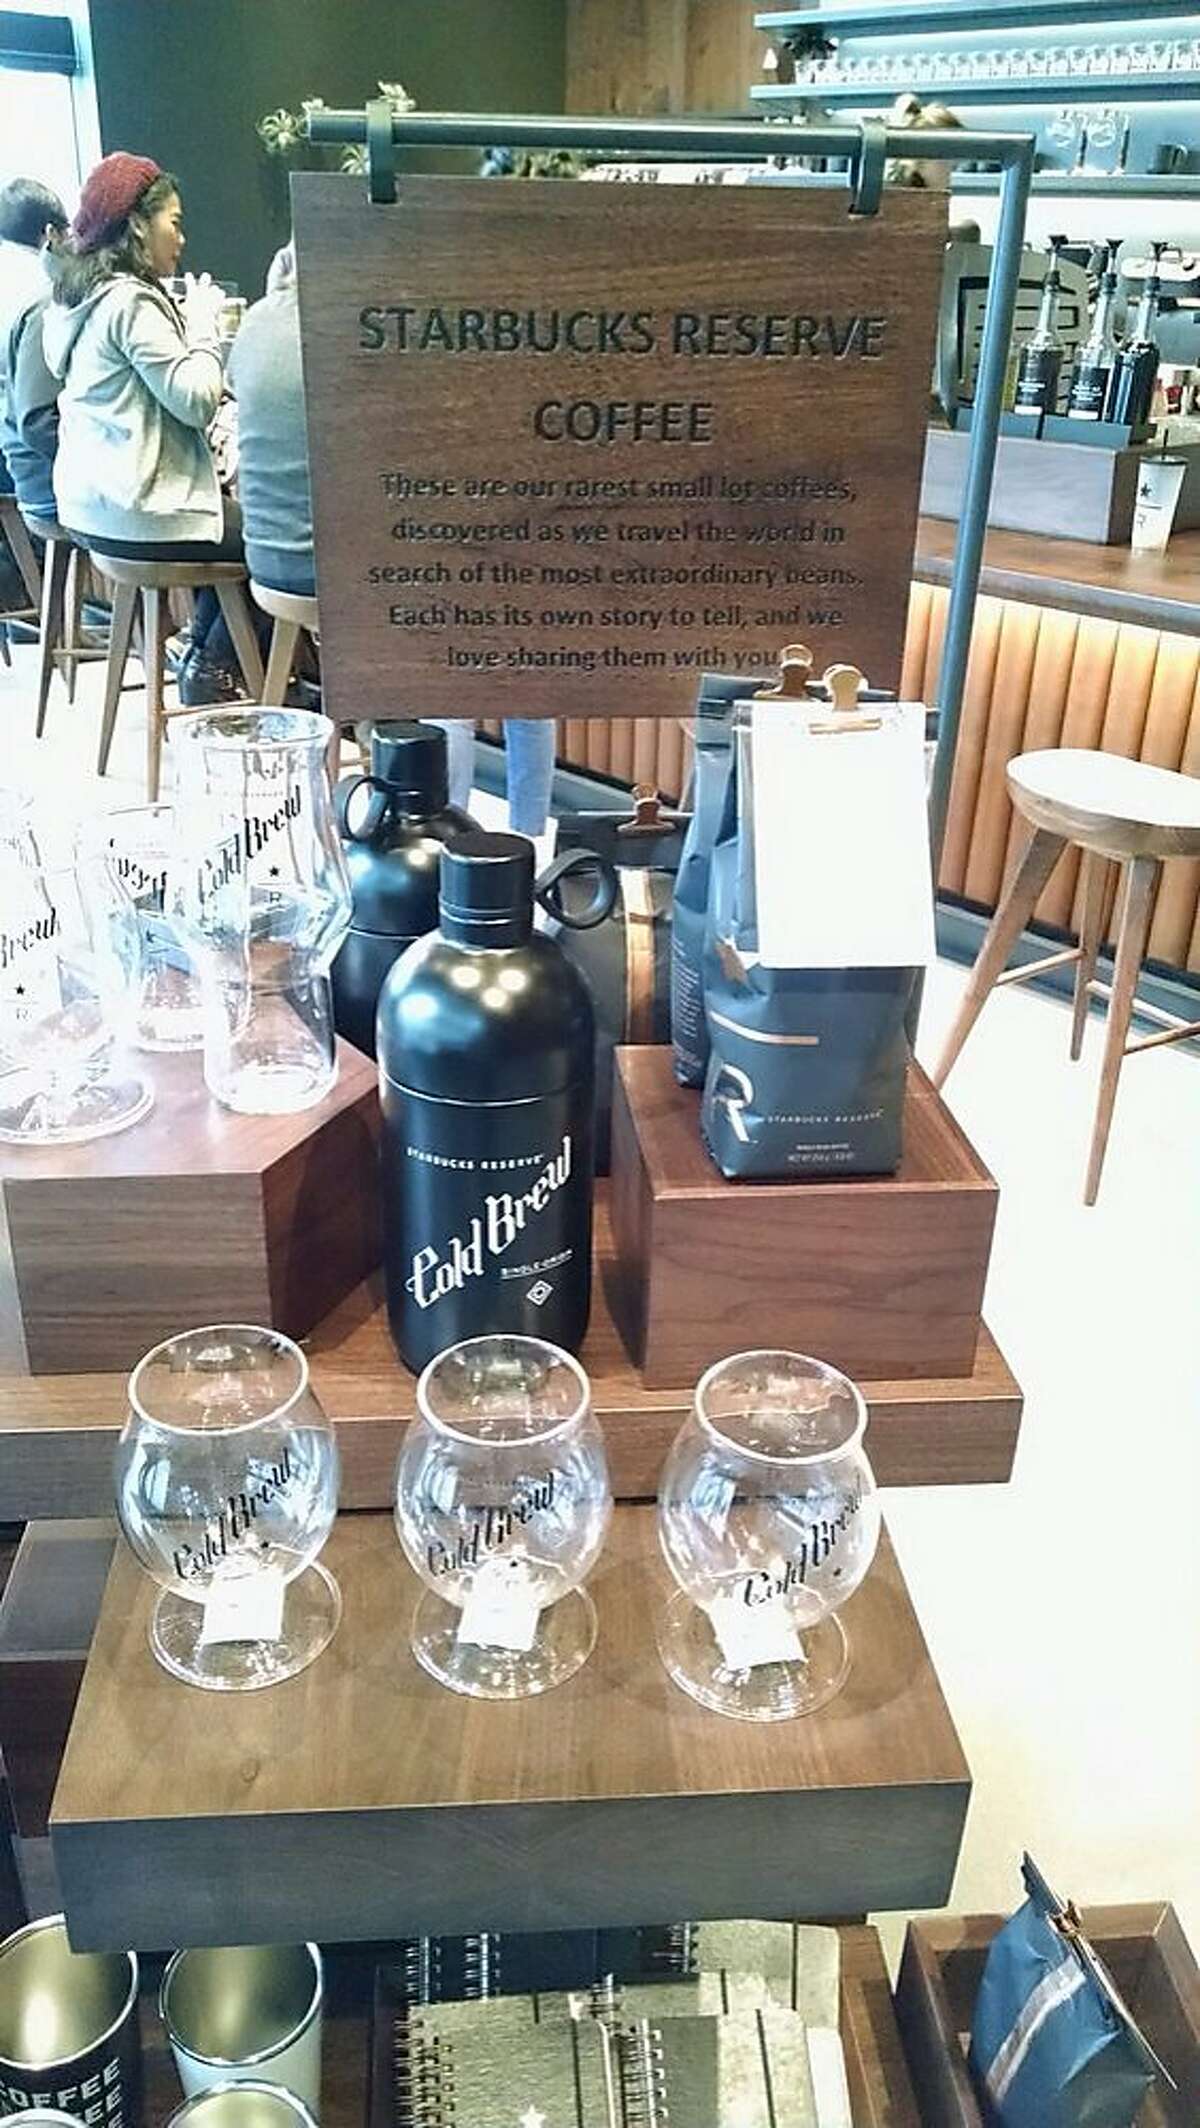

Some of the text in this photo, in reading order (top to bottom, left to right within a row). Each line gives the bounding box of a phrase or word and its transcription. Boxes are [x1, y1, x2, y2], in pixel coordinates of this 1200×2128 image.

[358, 306, 887, 360] STARBUCKS RESERVE
[533, 400, 715, 446] COFFEE
[380, 472, 858, 502] These are our rarest small lot coffees,
[391, 516, 846, 545] discovered as we travel the world in
[368, 561, 451, 586] search
[458, 562, 485, 583] of
[490, 562, 534, 584] the
[541, 565, 604, 585] most
[611, 563, 777, 589] extraordinary
[389, 603, 843, 631] Each has its own story to tell, and we
[447, 646, 500, 669] love
[507, 646, 597, 672] sharing
[603, 646, 666, 667] them
[673, 647, 726, 667] with
[243, 784, 302, 859] Brew
[407, 1146, 542, 1169] STARBUCKS RESERVE
[405, 1135, 571, 1309] Cold Brew
[173, 1446, 291, 1579] Cold Brew
[427, 1471, 554, 1576] Cold Brew
[743, 1472, 861, 1606] Cold Brew
